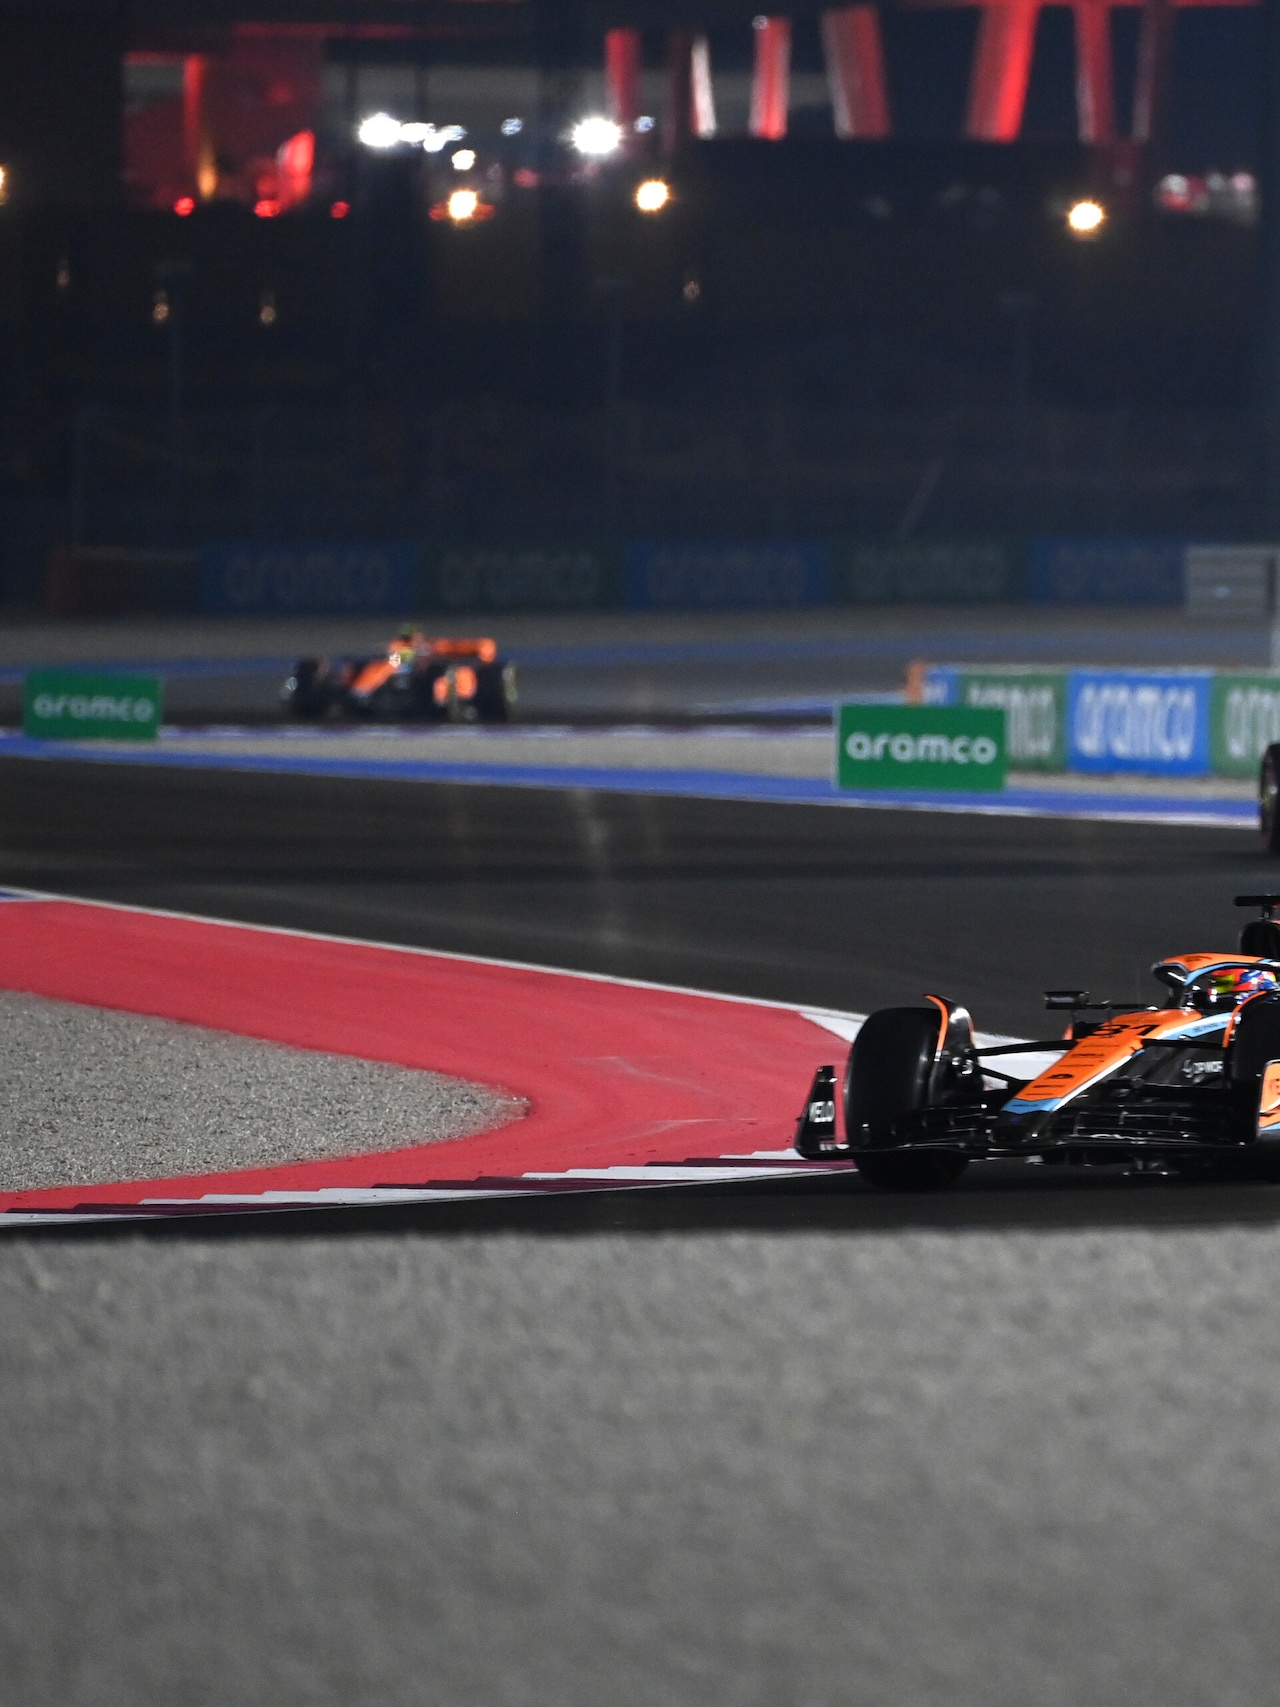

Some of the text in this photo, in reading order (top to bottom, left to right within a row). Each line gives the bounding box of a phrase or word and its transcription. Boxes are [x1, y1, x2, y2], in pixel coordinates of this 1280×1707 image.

[33, 694, 154, 722] aramco
[1074, 684, 1197, 761] aramco
[845, 732, 998, 765] aramco
